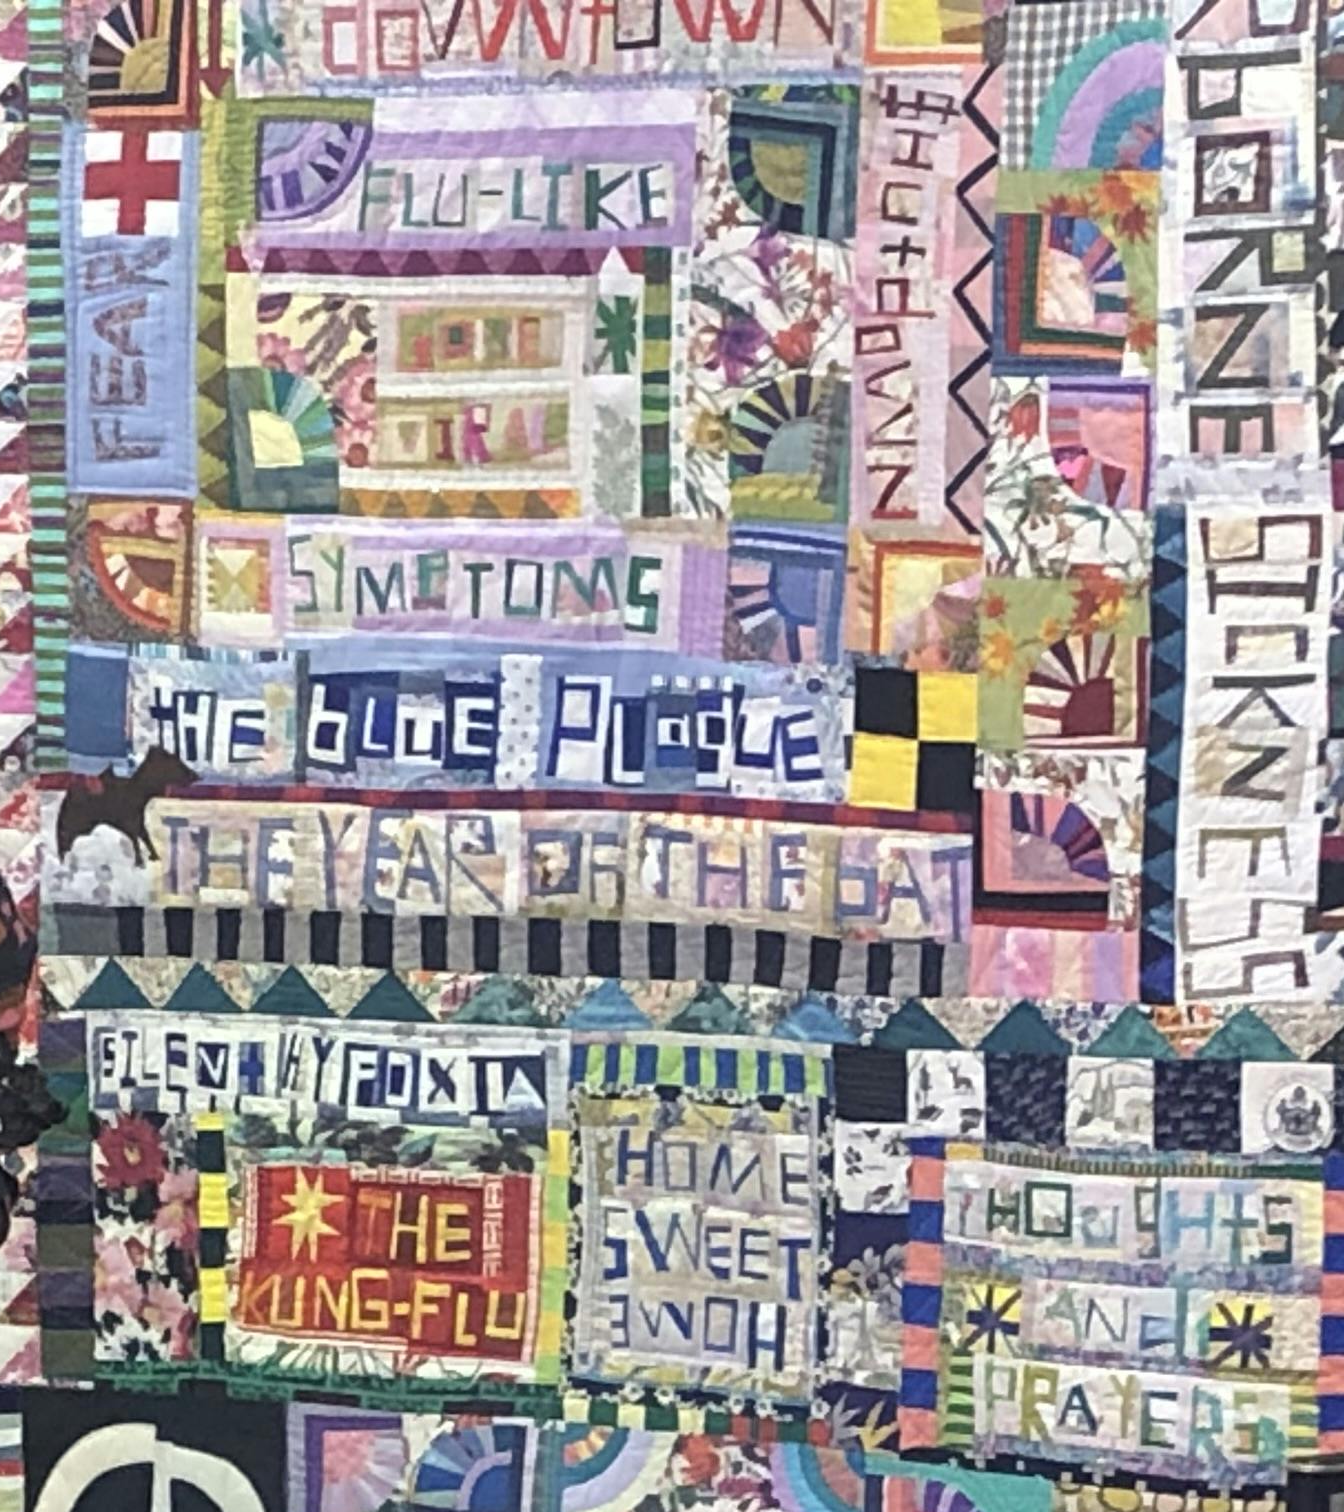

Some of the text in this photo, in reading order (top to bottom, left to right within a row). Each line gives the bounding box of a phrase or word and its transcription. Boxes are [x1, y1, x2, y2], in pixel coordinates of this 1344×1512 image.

[358, 161, 668, 232] FLU-LIKE
[84, 236, 172, 462] FEAR
[287, 533, 663, 634] SYMPTOMS
[1176, 514, 1324, 999] SICKNESS
[161, 815, 295, 907] THE
[319, 807, 504, 915] YEAR
[617, 1130, 809, 1205] HOME
[357, 1187, 473, 1265] THE
[603, 1206, 812, 1301] SWEET
[238, 1267, 526, 1346] KUNG-FLU
[984, 1361, 1290, 1468] PRAYERS
